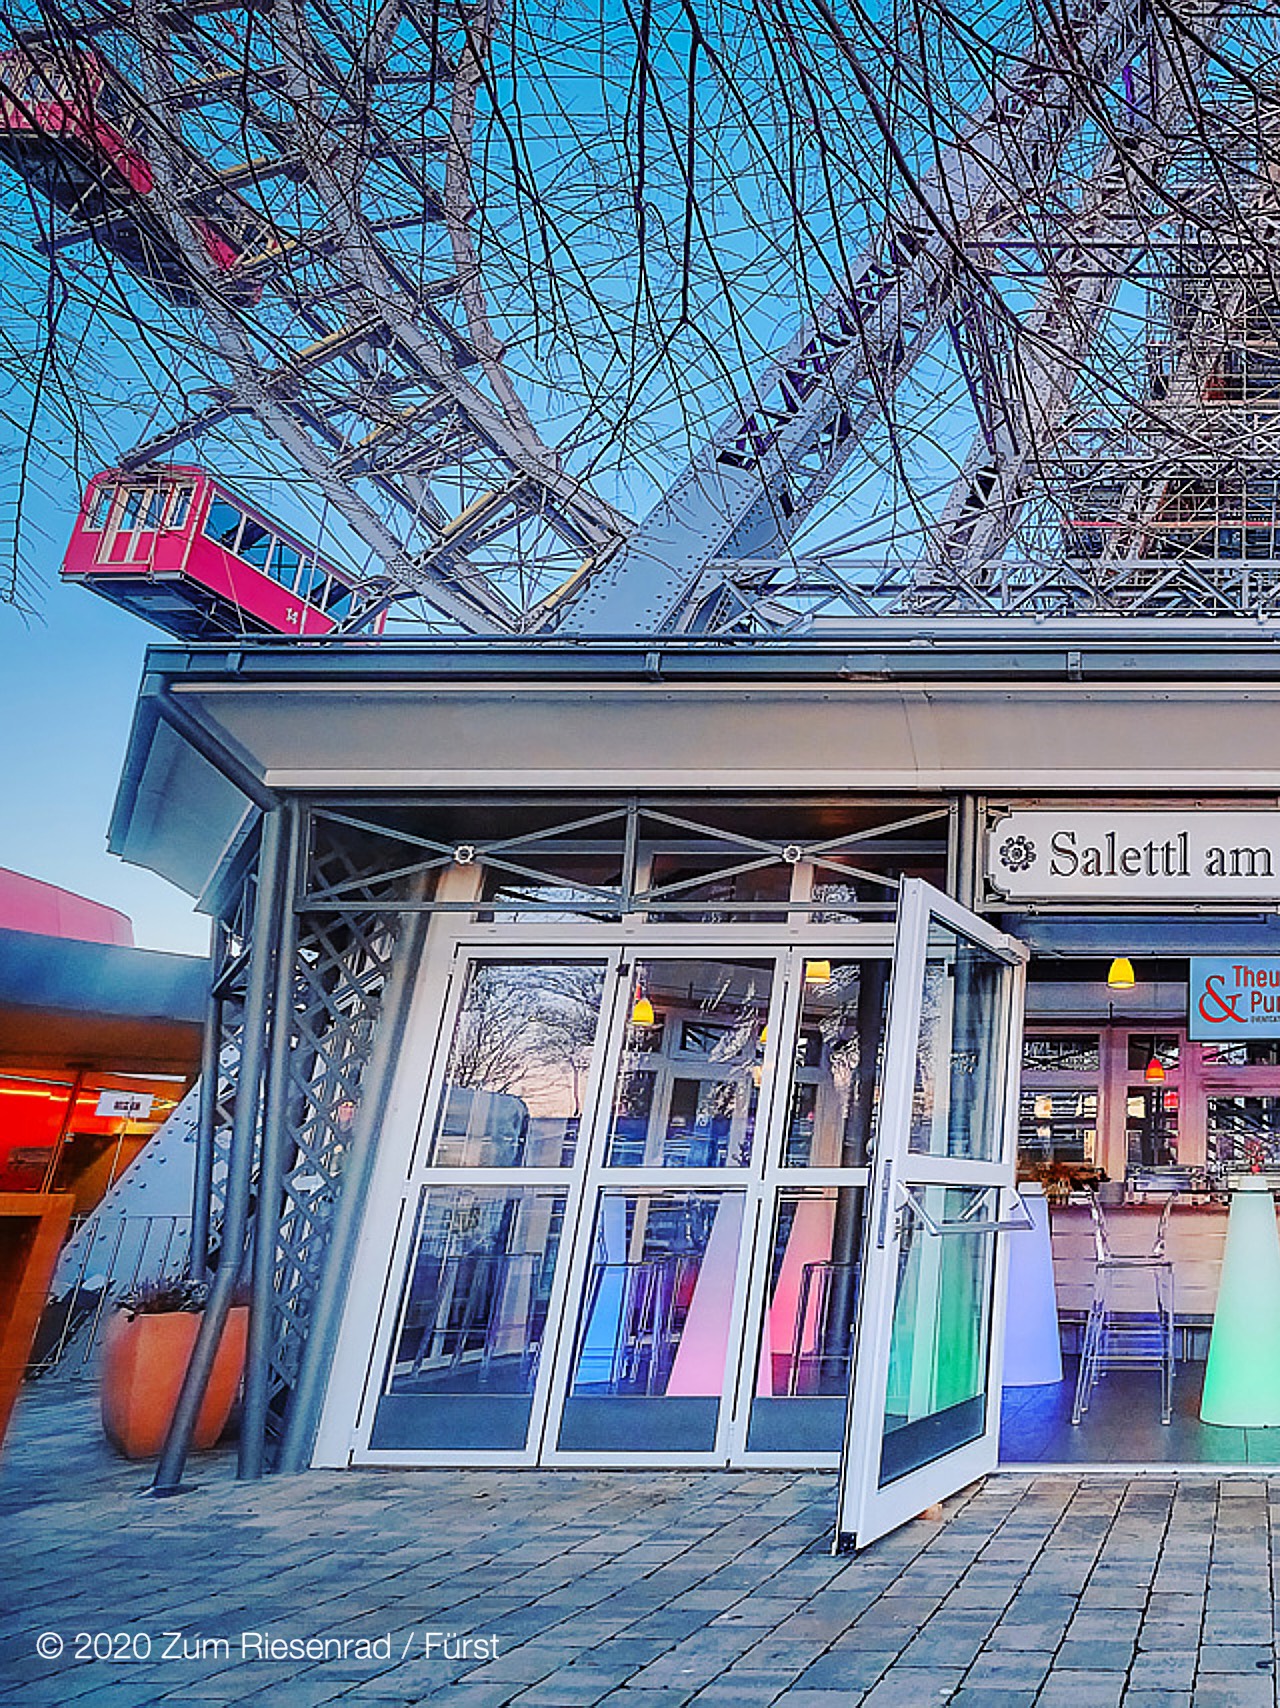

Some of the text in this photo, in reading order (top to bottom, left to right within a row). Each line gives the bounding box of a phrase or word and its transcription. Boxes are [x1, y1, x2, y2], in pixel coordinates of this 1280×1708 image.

[1049, 831, 1192, 878] Salettl
[1203, 846, 1275, 878] am
[1198, 974, 1249, 1024] &
